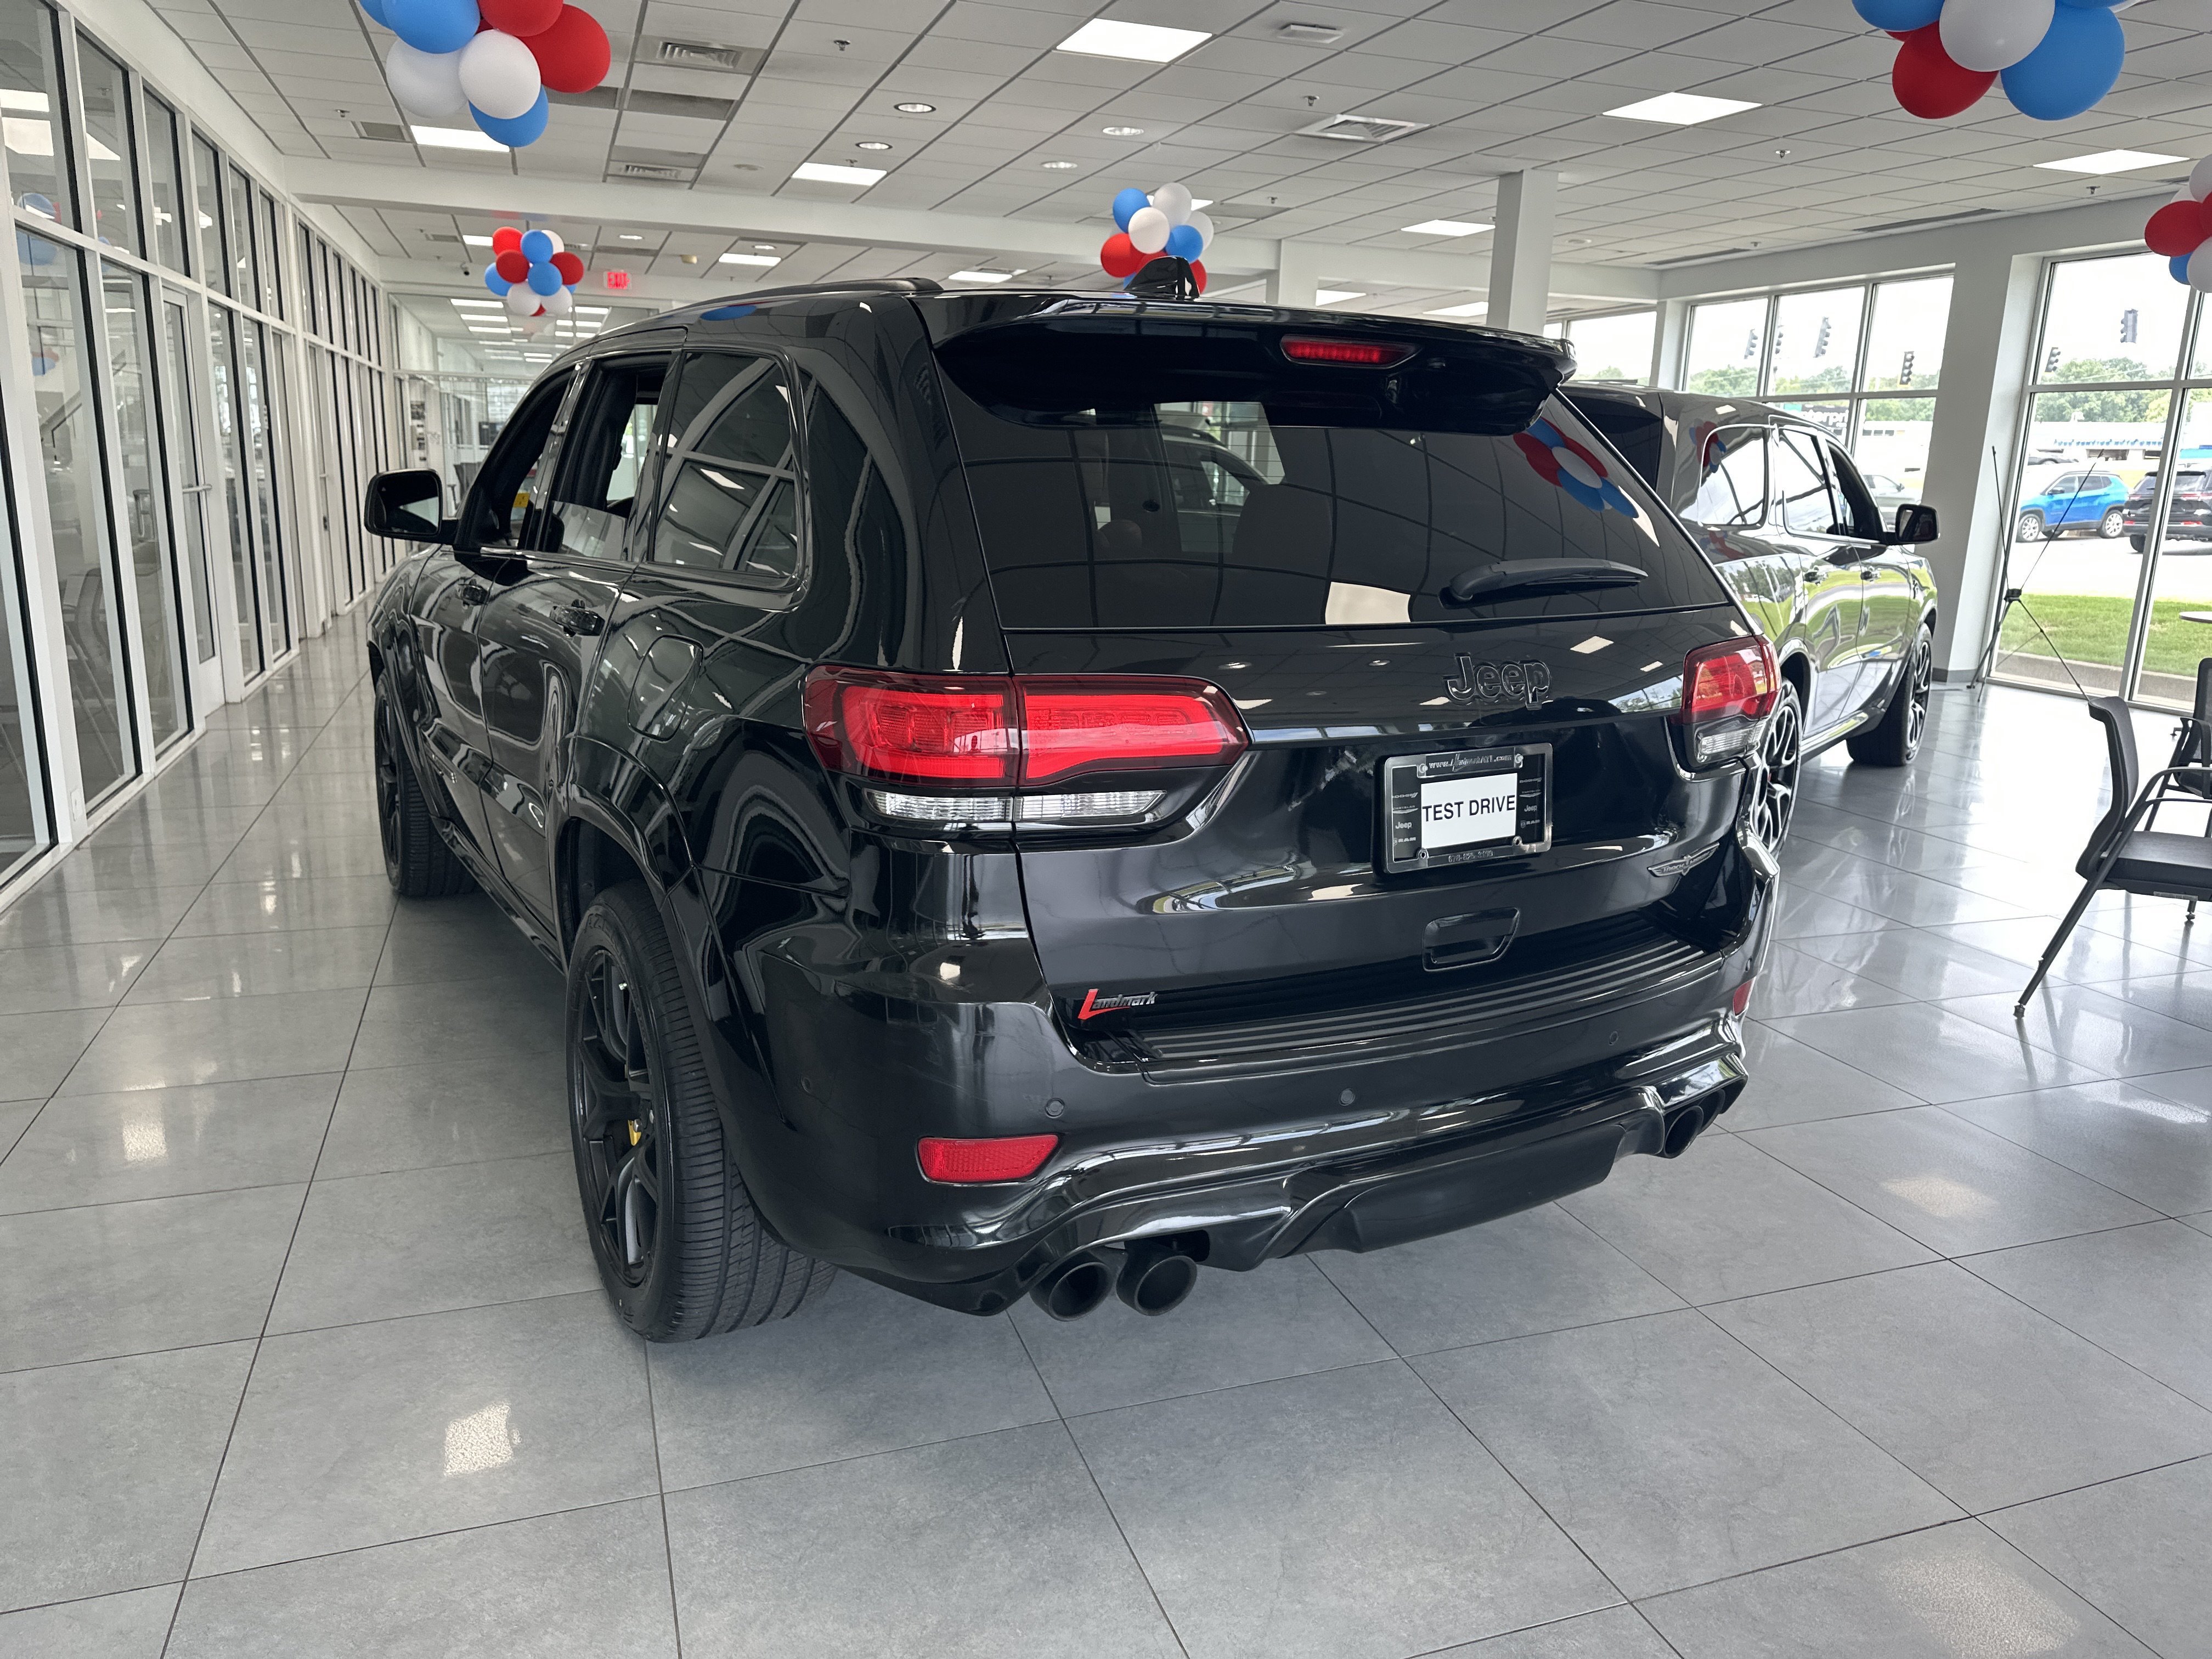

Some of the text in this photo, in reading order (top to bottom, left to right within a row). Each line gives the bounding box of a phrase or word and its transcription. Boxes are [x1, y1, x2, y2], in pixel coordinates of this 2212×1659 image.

[1442, 652, 1551, 710] Jeep
[1422, 795, 1516, 822] TEST DRIVE
[1077, 988, 1159, 1020] Landmark
